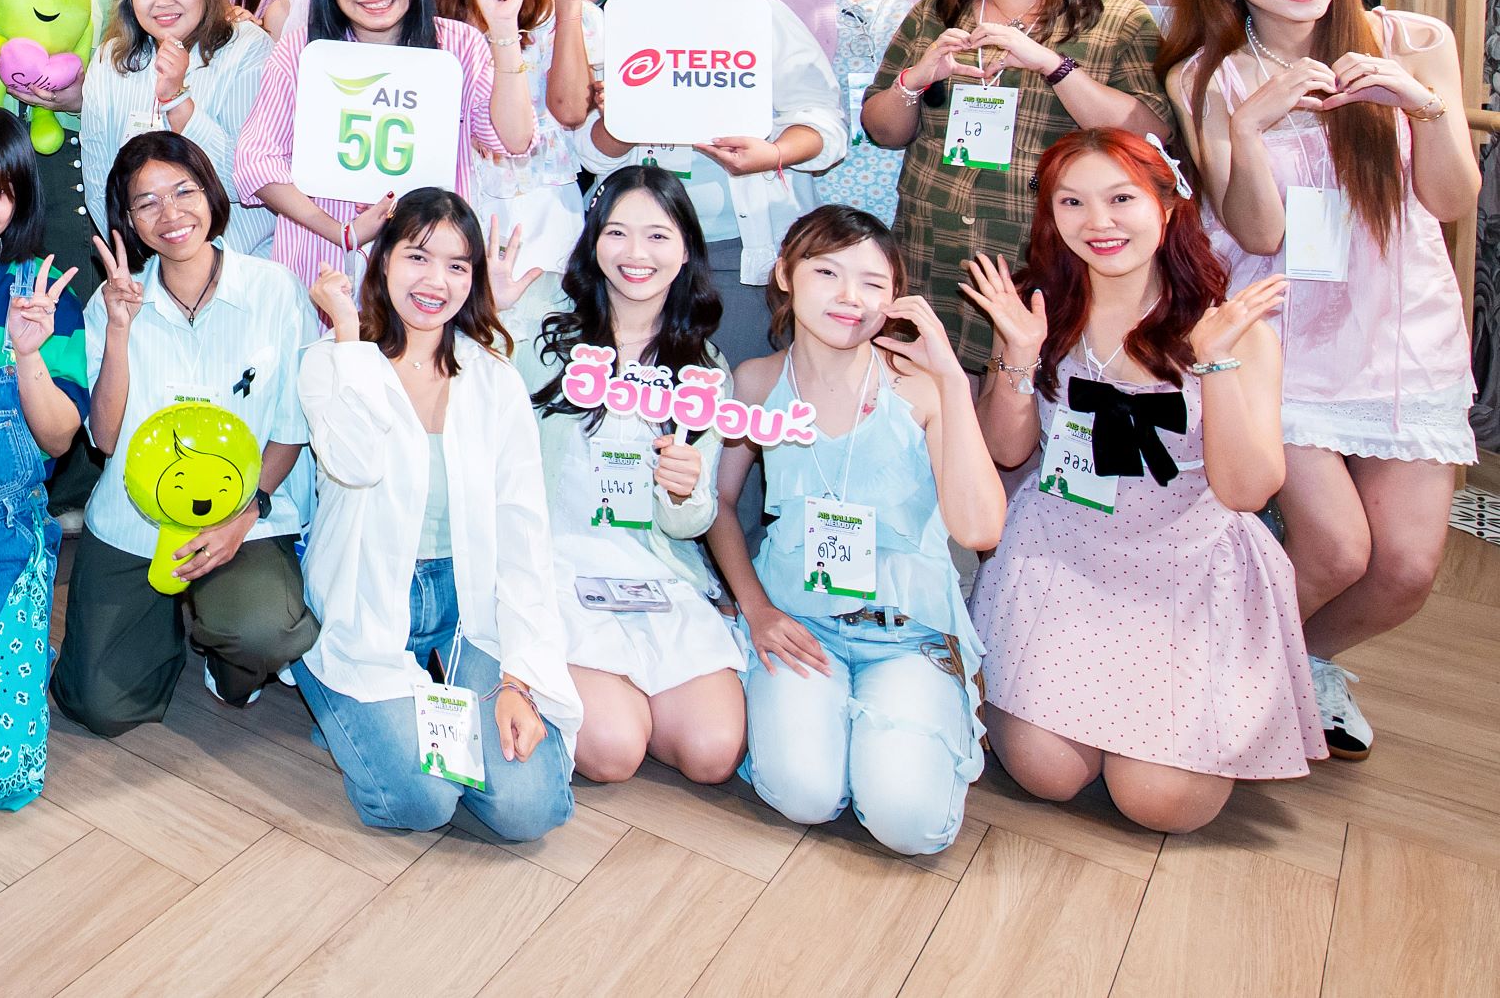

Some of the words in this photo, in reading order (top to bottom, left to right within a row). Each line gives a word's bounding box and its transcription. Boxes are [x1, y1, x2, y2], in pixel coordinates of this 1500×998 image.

[666, 49, 757, 70] TERO
[673, 71, 756, 88] MUSIC
[372, 87, 418, 109] AIS
[337, 108, 415, 176] 5G
[601, 479, 633, 494] แพร
